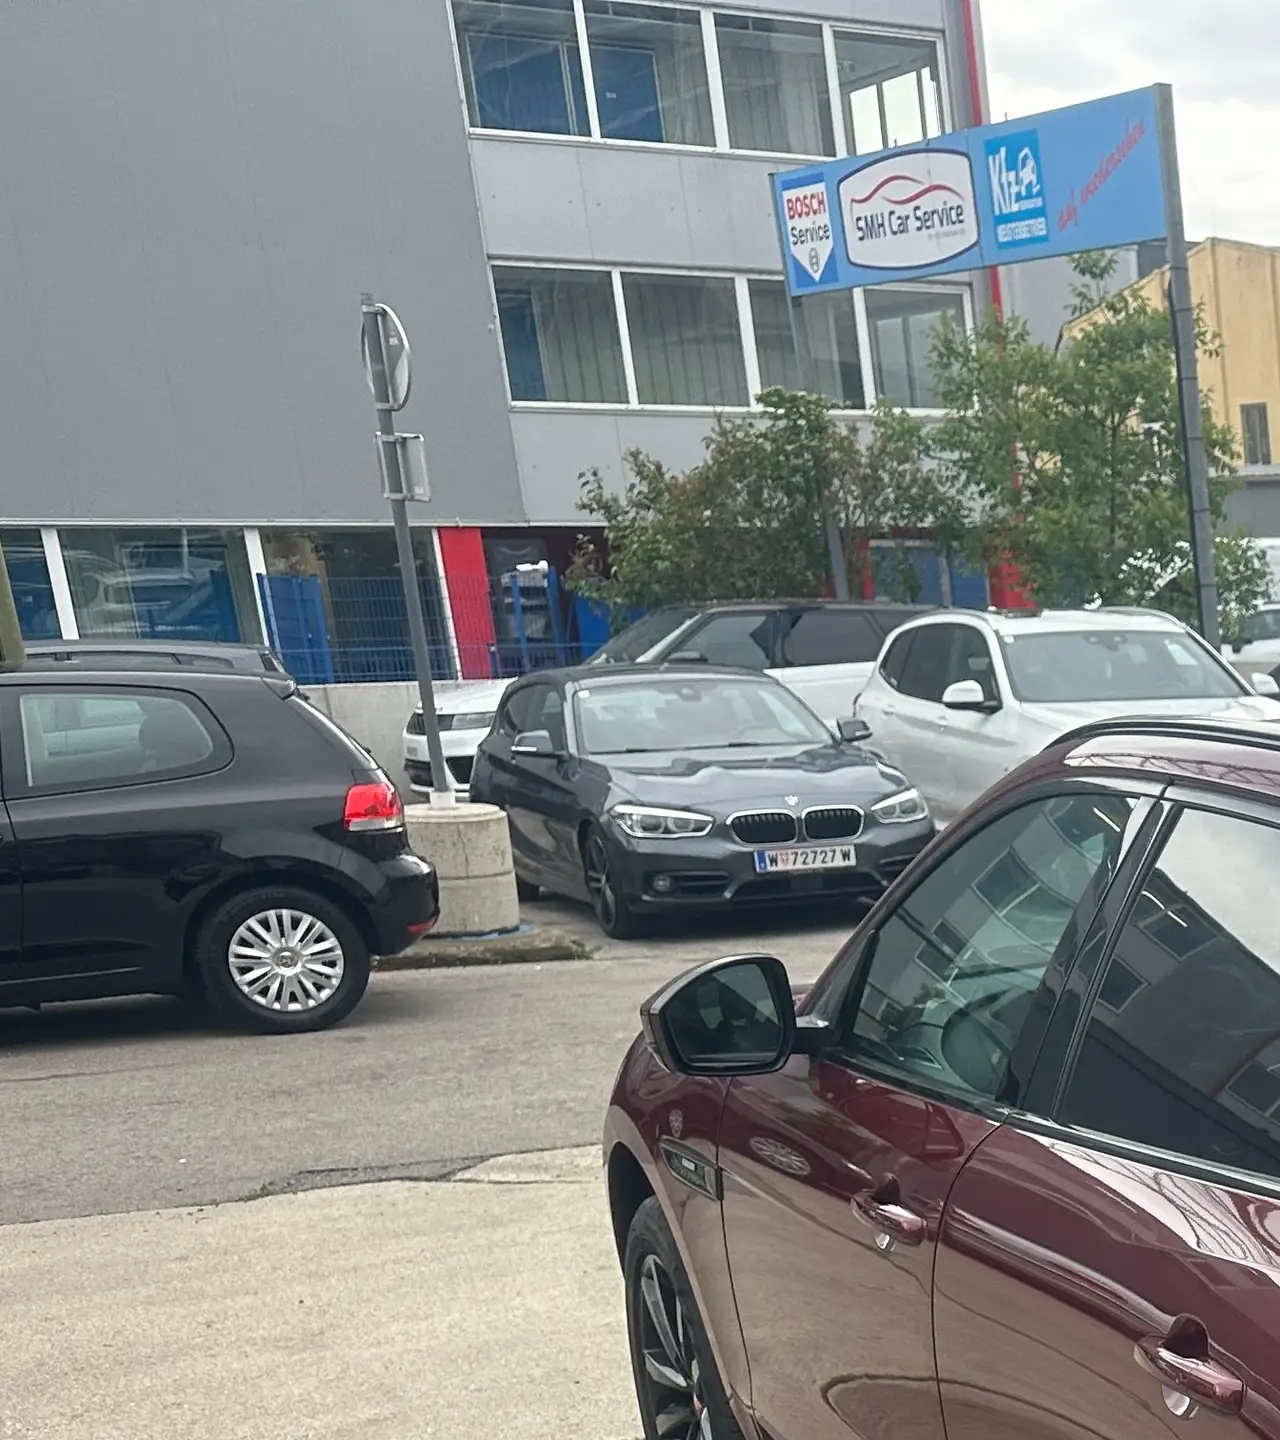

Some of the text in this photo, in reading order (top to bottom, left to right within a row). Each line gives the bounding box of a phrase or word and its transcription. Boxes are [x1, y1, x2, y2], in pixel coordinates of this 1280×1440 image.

[786, 191, 827, 220] BOSCH
[790, 220, 830, 246] Service
[855, 211, 887, 241] SMH
[888, 209, 910, 236] Car
[913, 200, 965, 232] Service
[768, 848, 851, 868] W 72727 W
